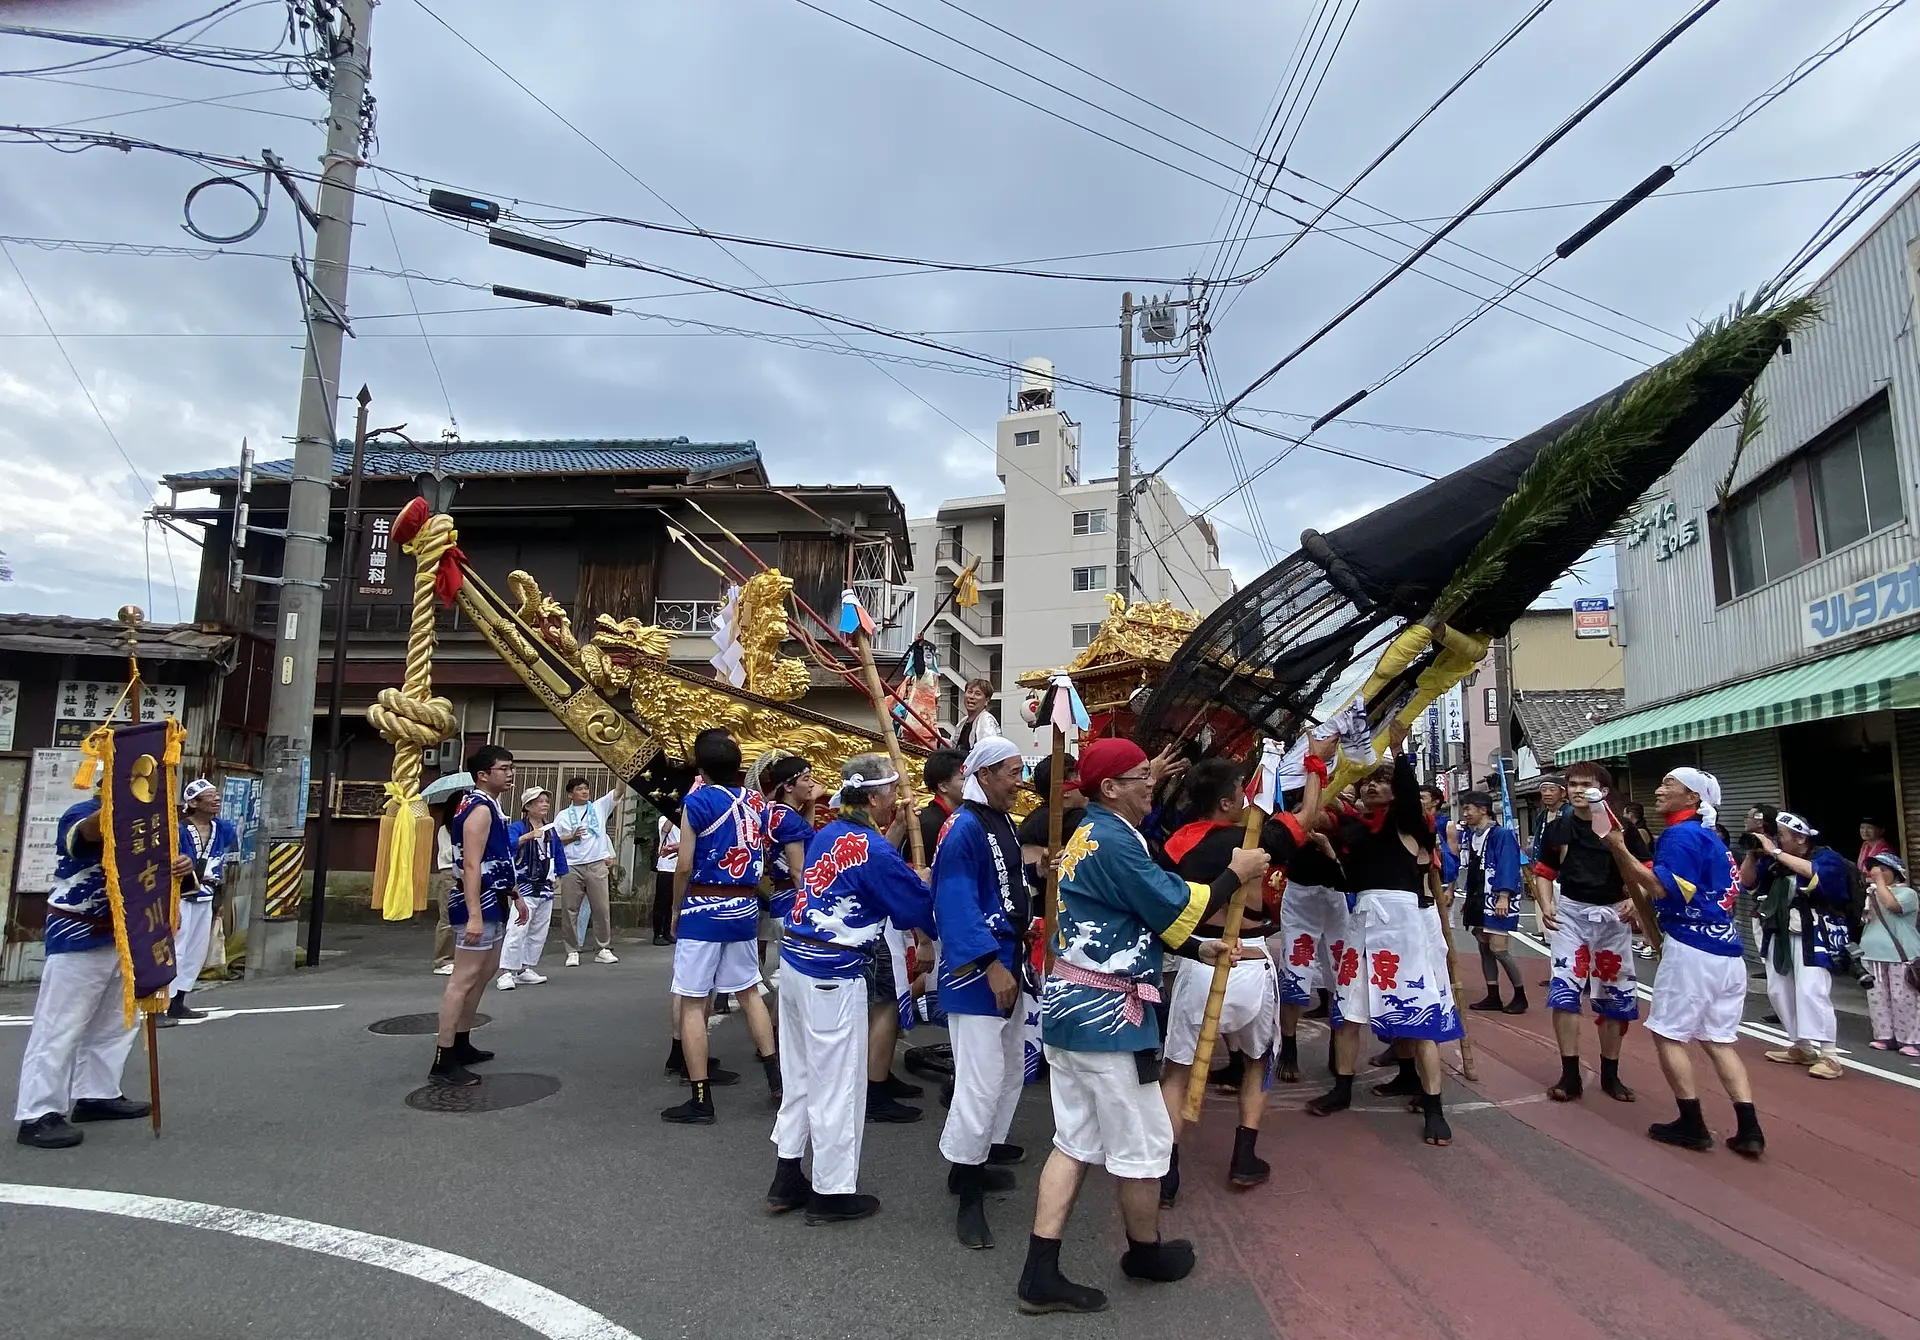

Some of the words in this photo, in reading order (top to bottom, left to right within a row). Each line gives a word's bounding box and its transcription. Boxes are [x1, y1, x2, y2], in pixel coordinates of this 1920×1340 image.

[368, 518, 390, 585] 生川歯科
[1582, 616, 1605, 624] ZETT
[138, 859, 174, 967] 古川町
